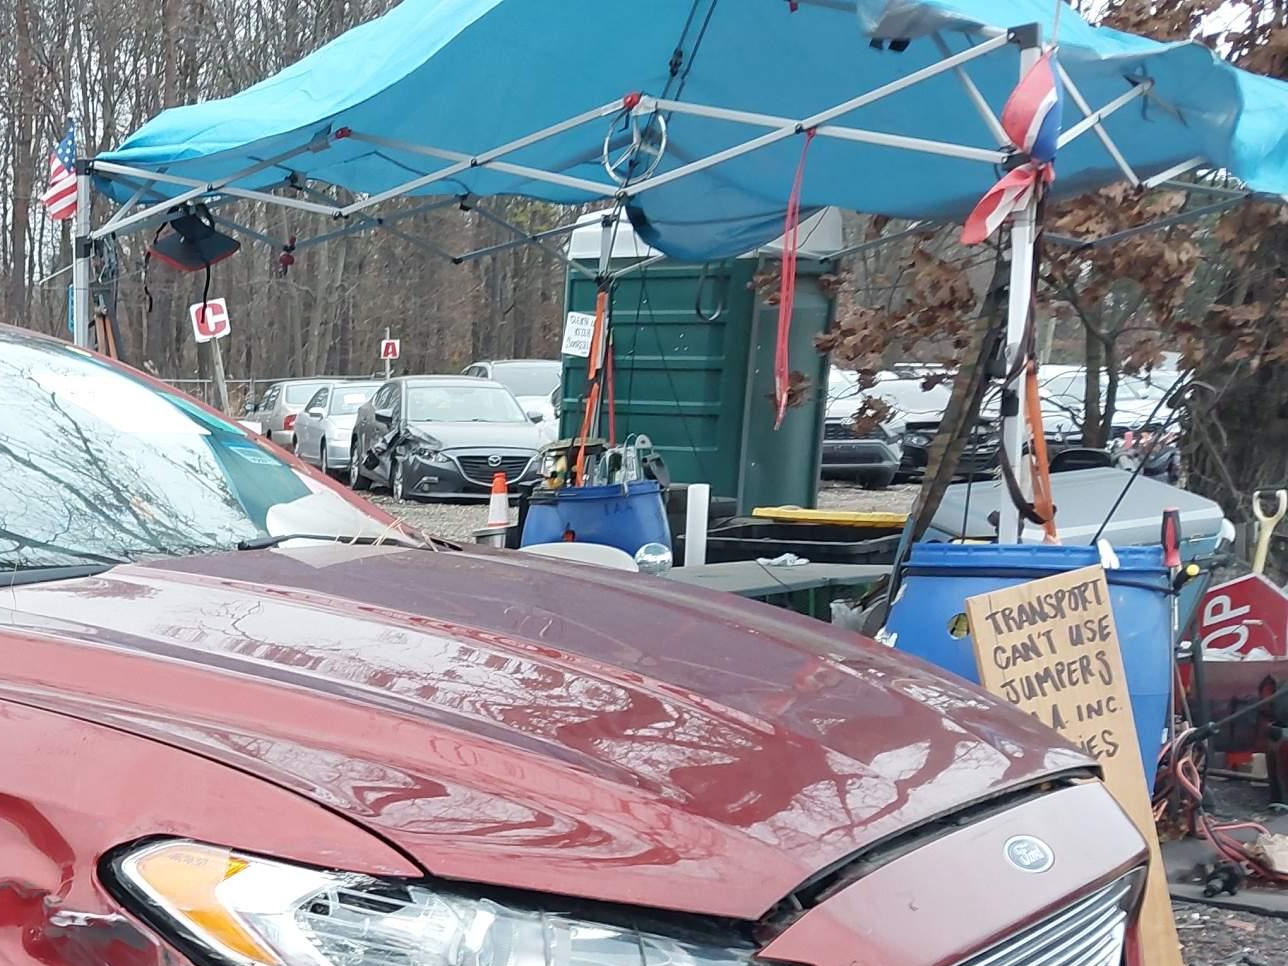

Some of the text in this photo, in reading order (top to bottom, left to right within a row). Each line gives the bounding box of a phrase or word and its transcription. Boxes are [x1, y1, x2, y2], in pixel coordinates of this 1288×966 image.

[195, 302, 227, 337] C
[383, 341, 398, 359] A
[985, 578, 1104, 636] TRANSPORT
[993, 614, 1112, 671] CAN'T USE
[1000, 650, 1113, 705] JUMPERS
